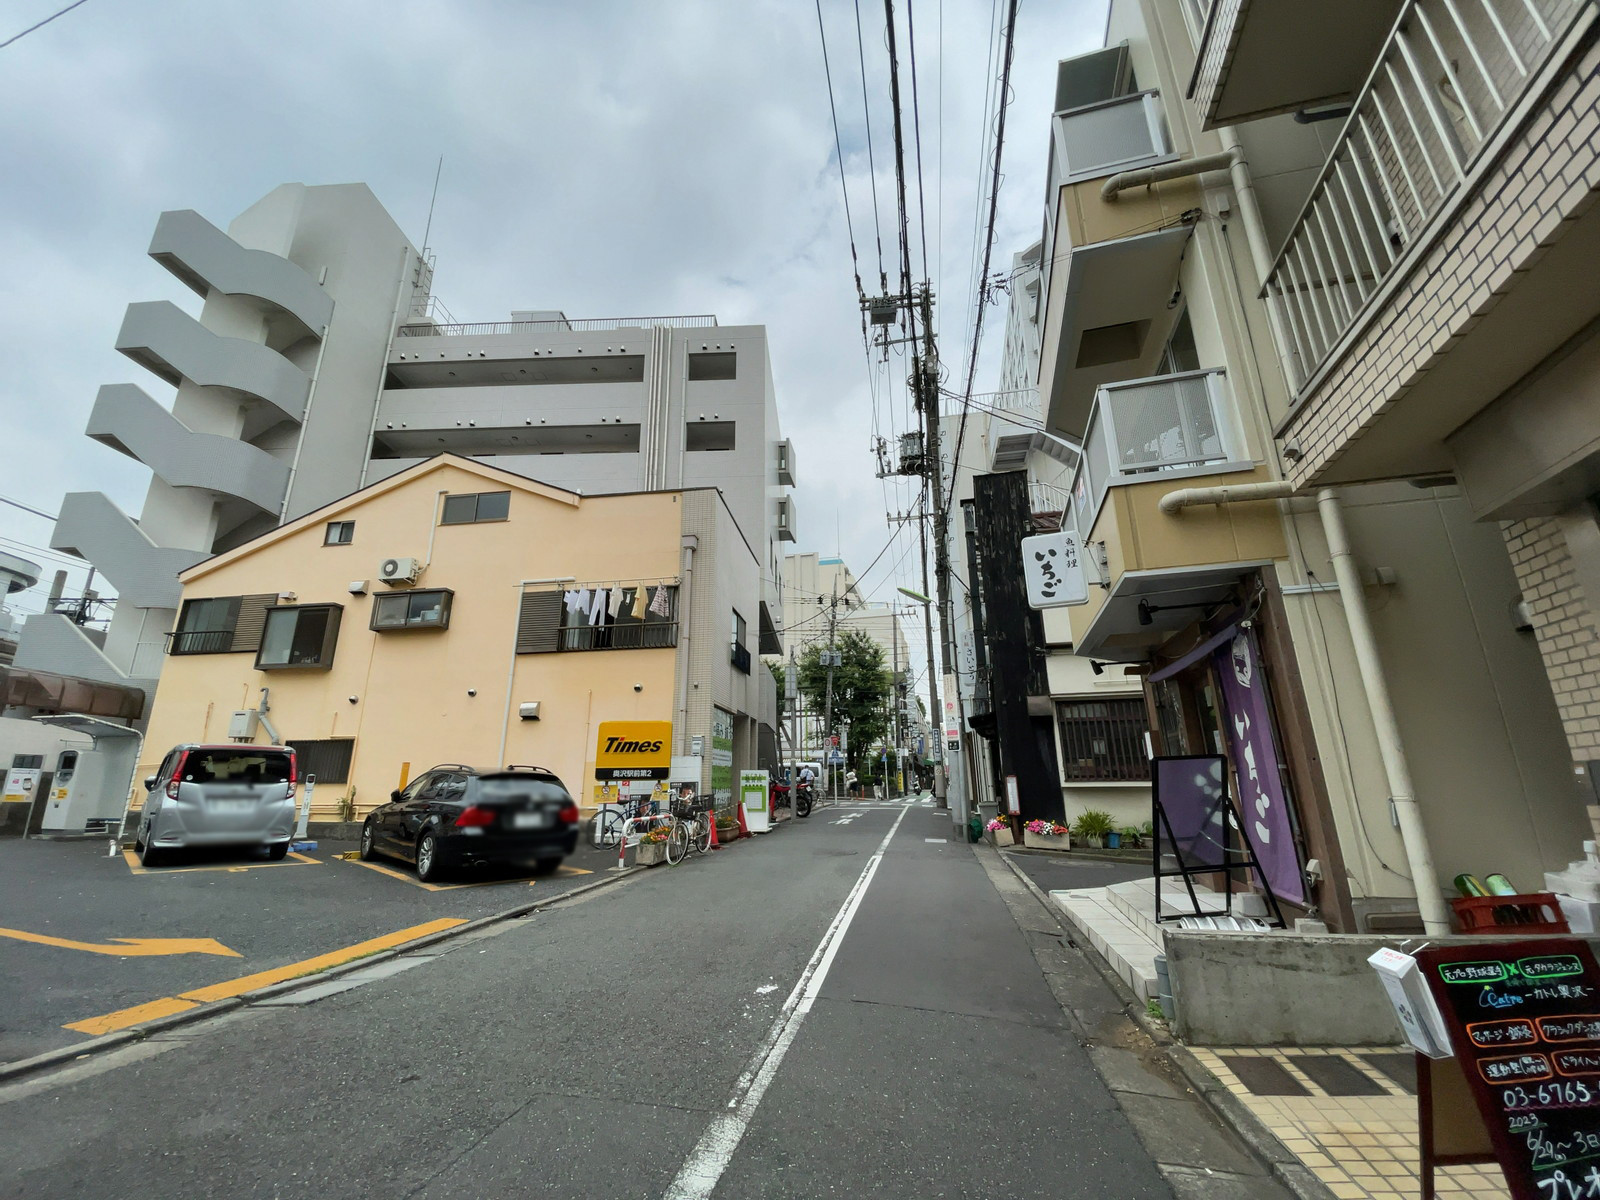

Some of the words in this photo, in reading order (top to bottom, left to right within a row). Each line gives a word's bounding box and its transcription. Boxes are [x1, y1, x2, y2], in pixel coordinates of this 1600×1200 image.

[1064, 537, 1079, 569] 魚料理
[1034, 548, 1062, 598] いちご
[605, 737, 663, 753] Times
[1504, 1081, 1600, 1107] 03-6765-
[1508, 1113, 1539, 1128] 2023
